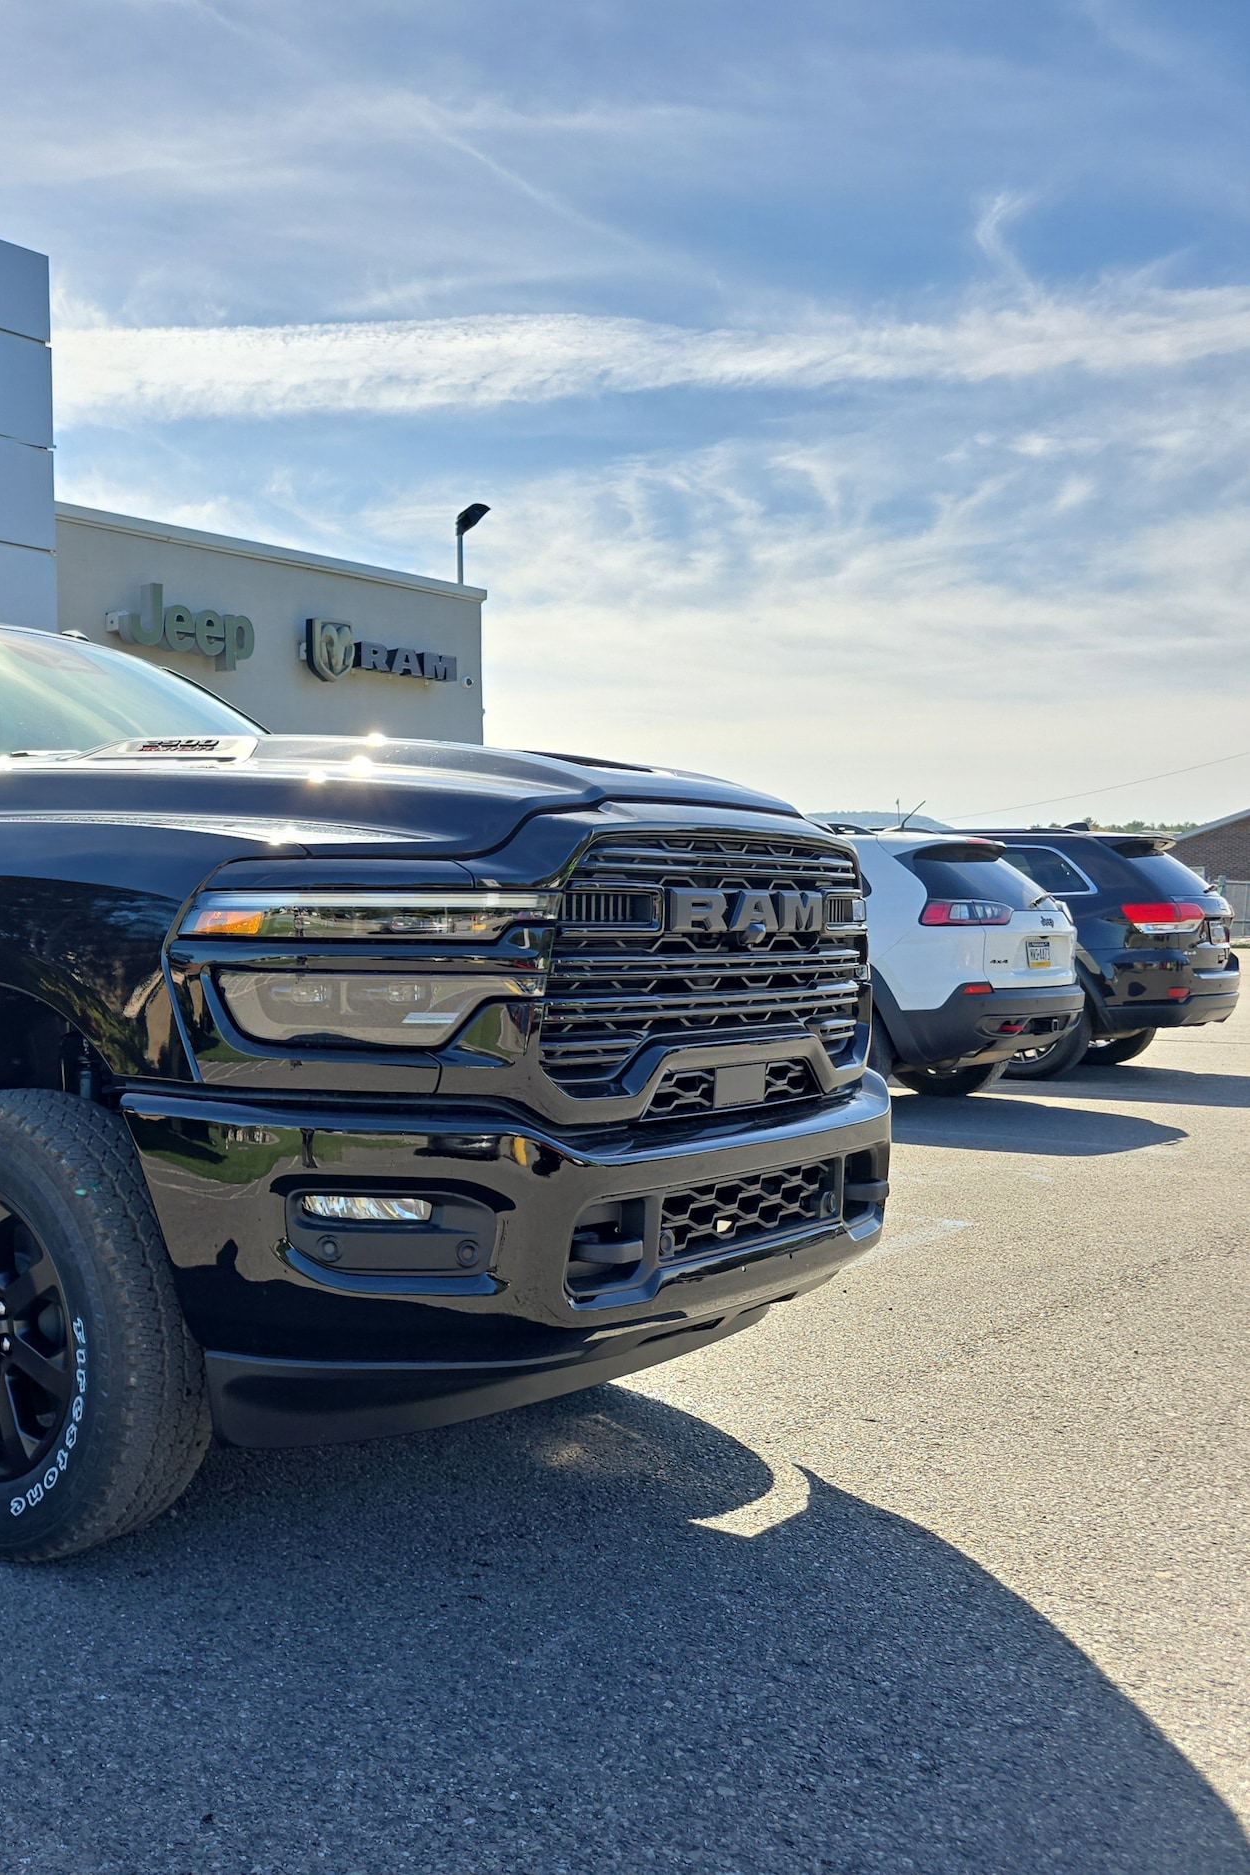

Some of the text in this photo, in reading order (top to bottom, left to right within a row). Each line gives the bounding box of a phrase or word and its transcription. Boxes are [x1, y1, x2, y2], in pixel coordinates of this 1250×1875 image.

[118, 582, 256, 672] Jeep
[352, 640, 458, 682] RAM
[663, 887, 823, 933] RAM
